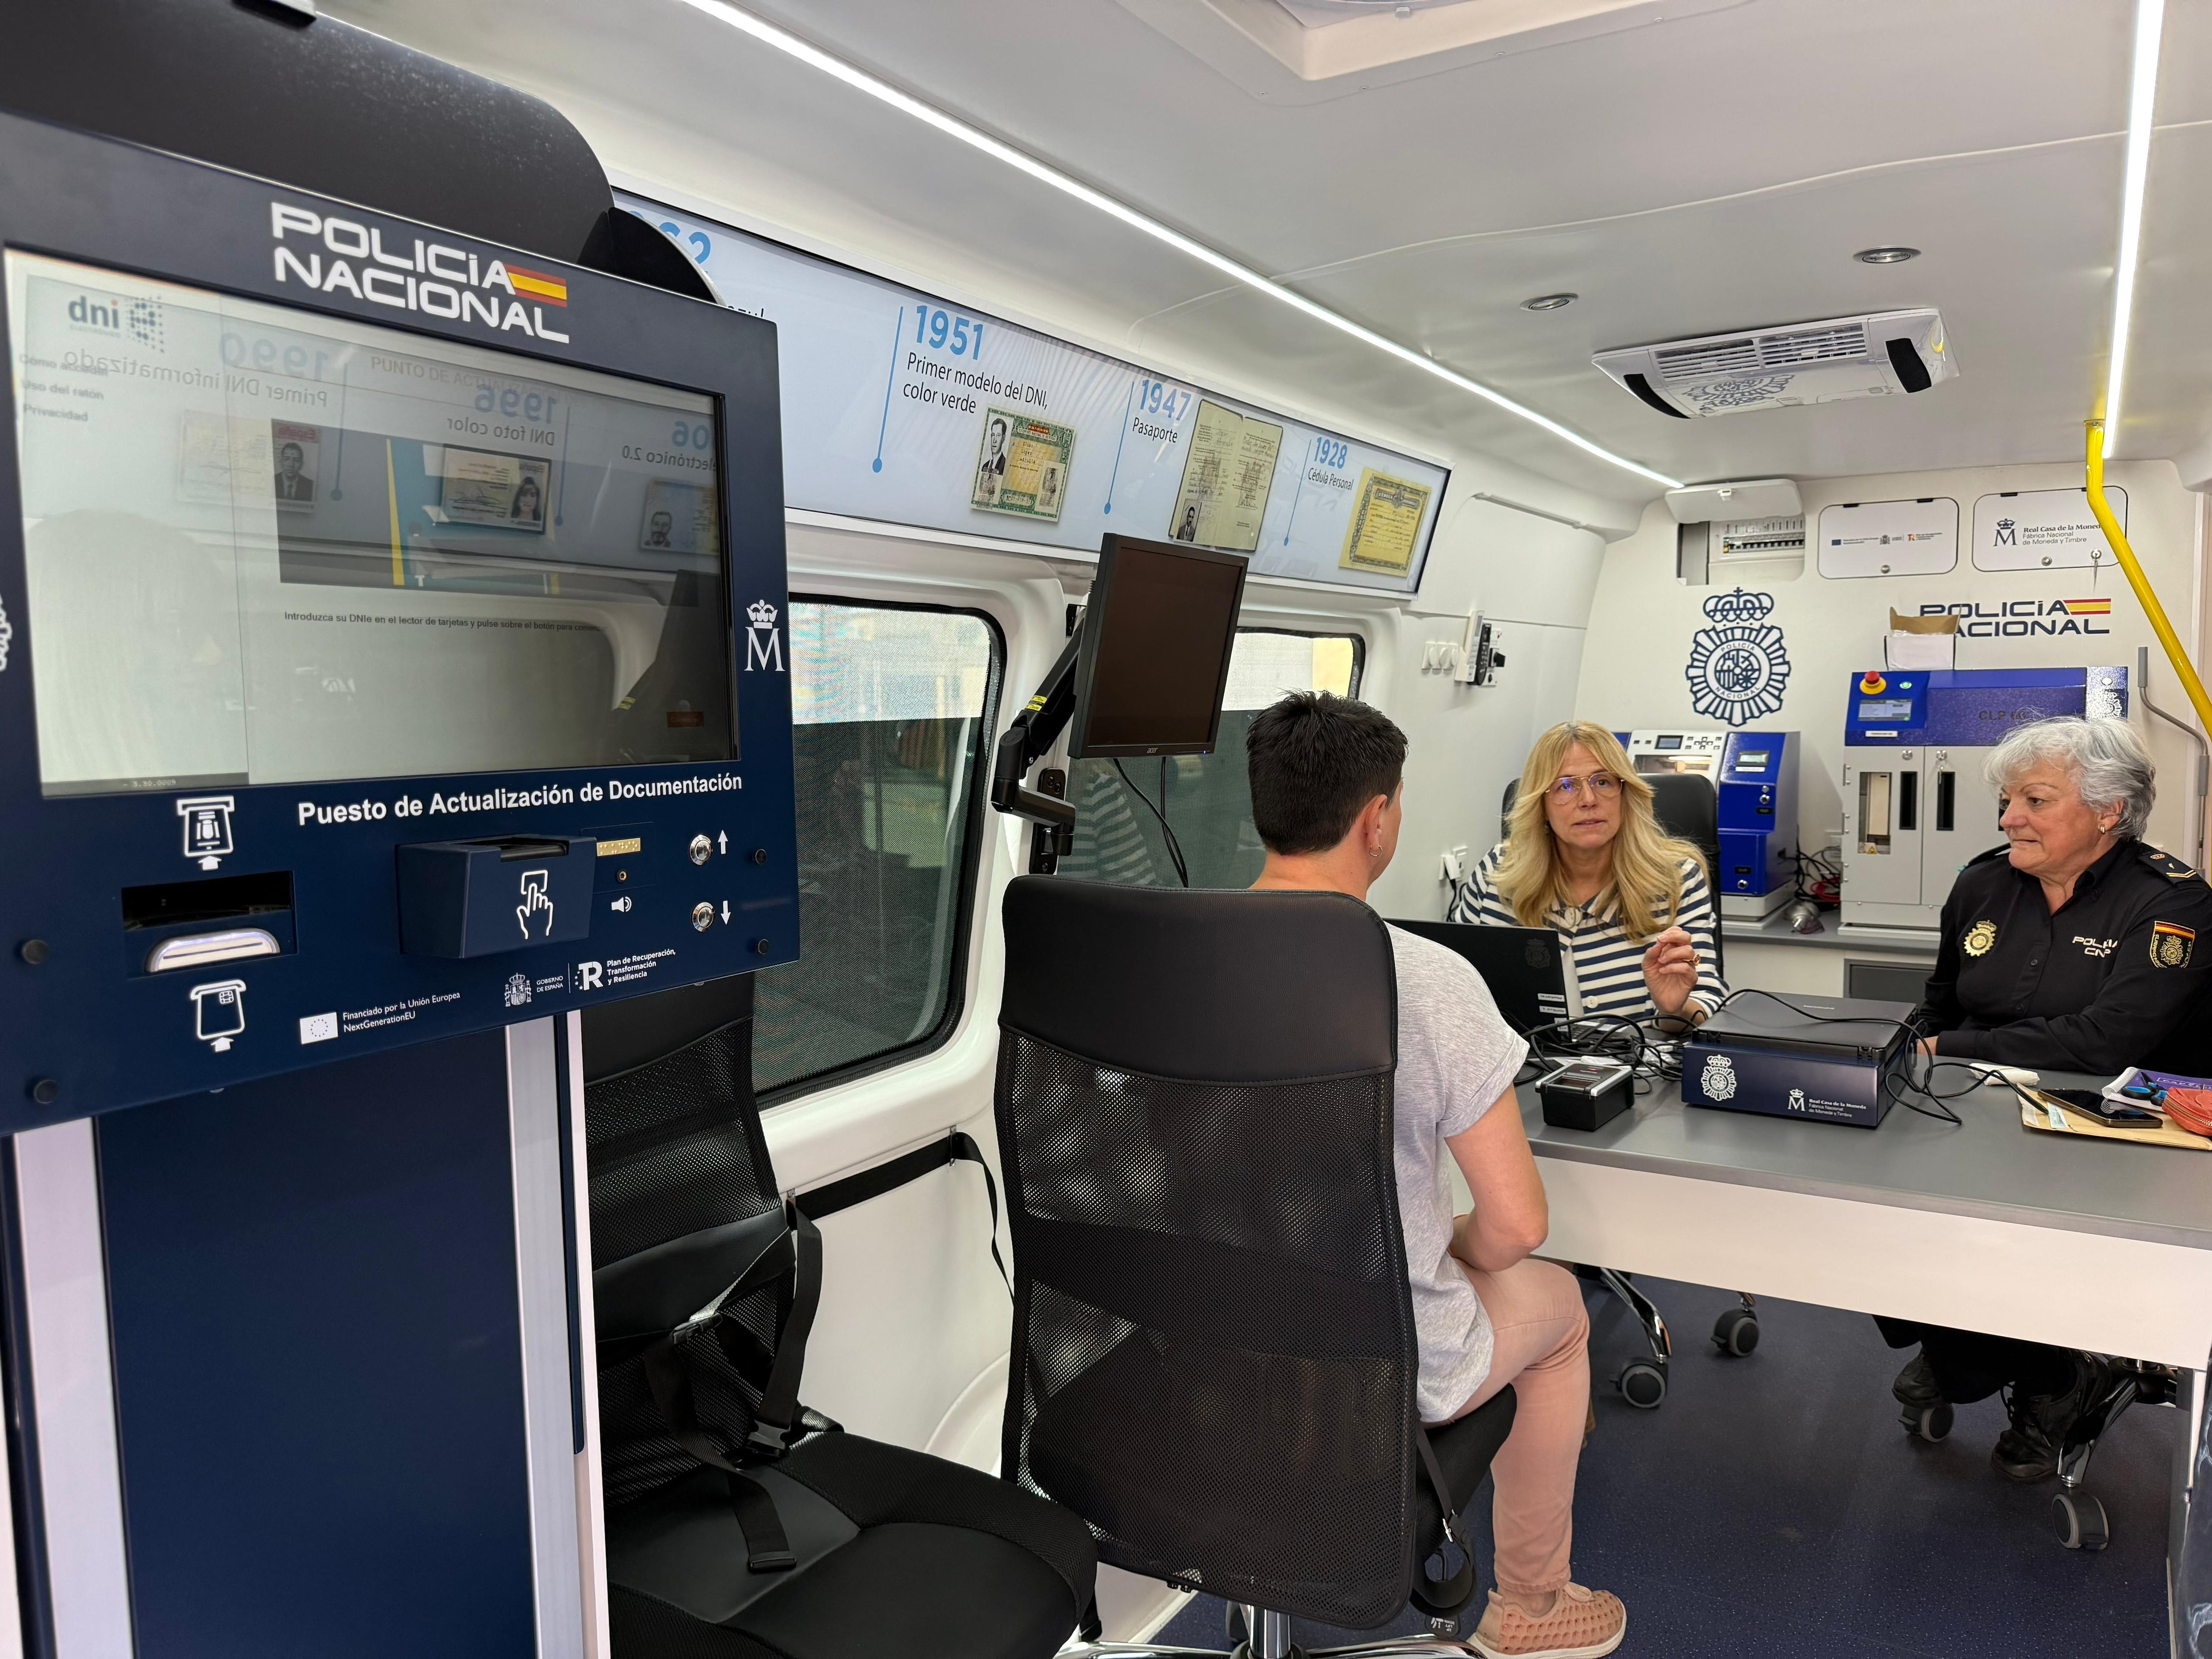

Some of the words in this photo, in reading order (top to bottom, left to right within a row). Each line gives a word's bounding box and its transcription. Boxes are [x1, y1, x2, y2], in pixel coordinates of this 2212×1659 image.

[274, 246, 569, 344] NACIONAL
[68, 295, 119, 329] dni
[916, 305, 983, 361] 1951
[371, 356, 425, 379] PUNTO
[429, 367, 449, 383] DE
[907, 352, 952, 381] Primer
[955, 367, 1002, 395] modelo
[1005, 382, 1023, 400] del
[1025, 385, 1048, 410] DNI,
[903, 382, 938, 405] color
[941, 389, 976, 415] verde
[1141, 379, 1192, 422] 1947
[1133, 417, 1178, 444] Pasaporte
[1313, 436, 1348, 470] 1928
[1308, 467, 1329, 485] Cédula
[1329, 473, 1355, 491] Personal
[285, 611, 333, 622] Introduzca
[349, 614, 372, 623] DNIe
[399, 616, 422, 625] lector
[425, 617, 437, 626] de
[438, 618, 468, 629] tarjetas
[477, 619, 499, 630] pulse
[534, 622, 555, 630] botón
[557, 623, 573, 632] para
[1715, 686, 1760, 699] NACIONAL
[1979, 710, 2006, 721] CLP
[298, 799, 387, 826] Puesto
[394, 795, 423, 818] de
[429, 784, 574, 815] Actualización
[580, 782, 603, 803] de
[609, 772, 742, 800] Documentación
[607, 960, 657, 976] Transformación
[632, 949, 676, 963] Recuperación,
[536, 975, 563, 986] GOBIERNO
[545, 983, 564, 991] ESPAÑA
[614, 971, 647, 984] Resiliencia
[343, 1006, 383, 1021] Financiado
[384, 1003, 398, 1013] por
[399, 1001, 406, 1010] la
[407, 997, 430, 1008] Unión
[432, 991, 461, 1004] Europea
[343, 1010, 416, 1033] NextGenerationEU
